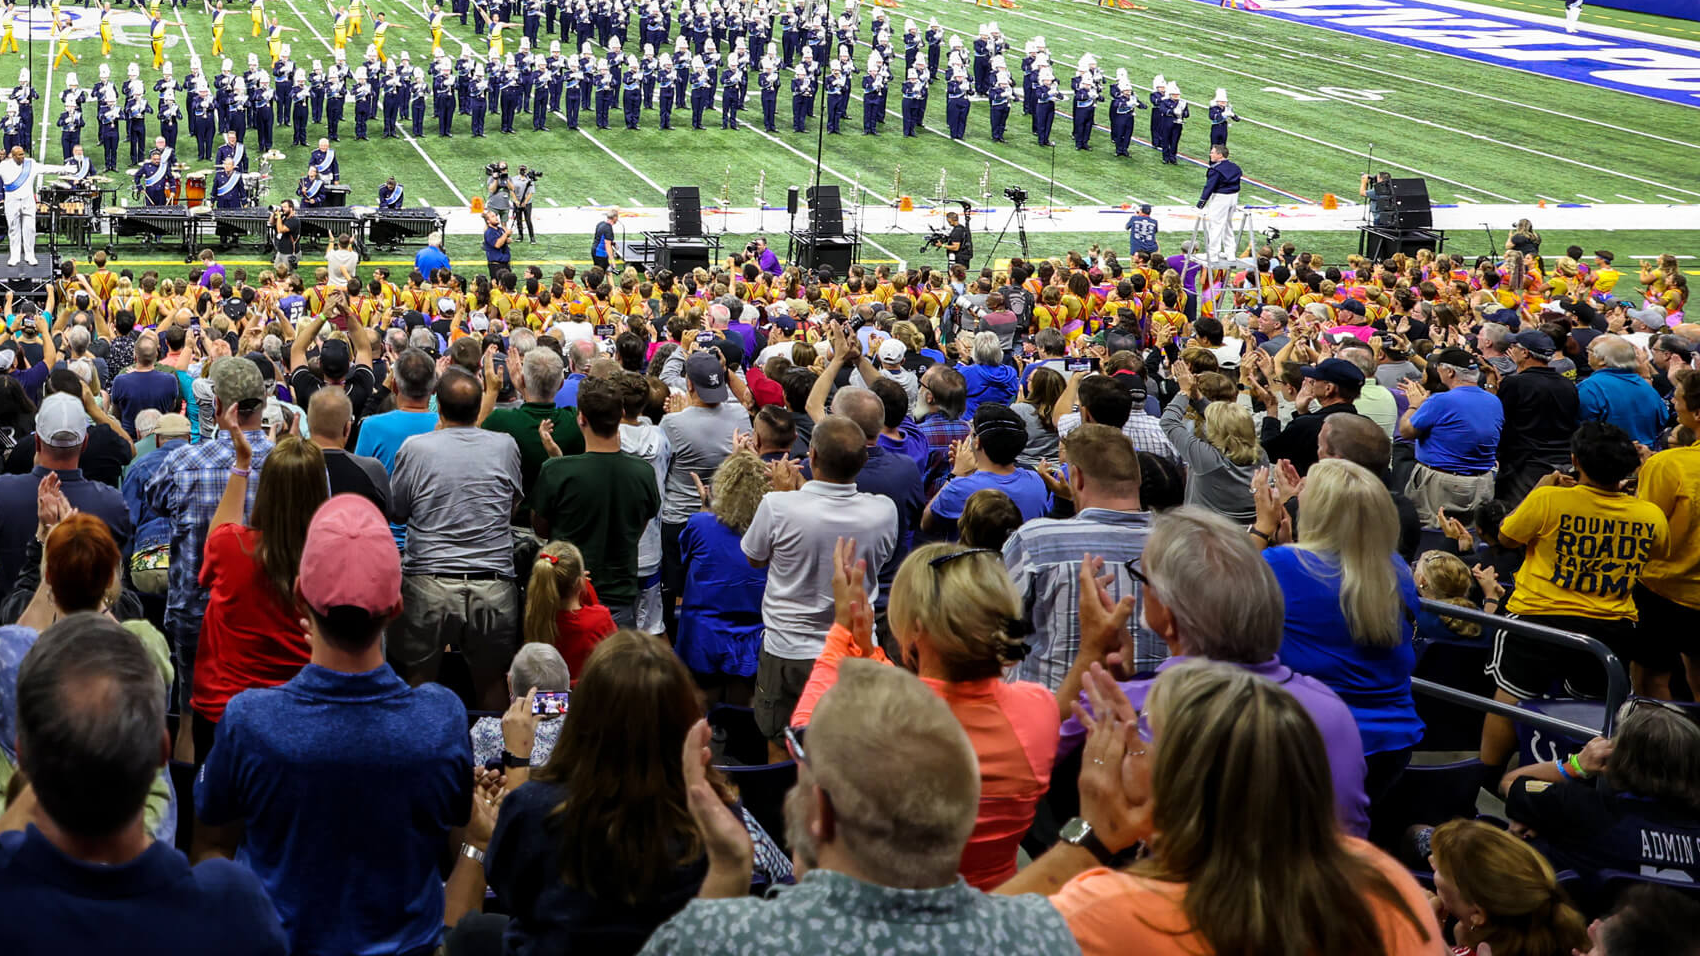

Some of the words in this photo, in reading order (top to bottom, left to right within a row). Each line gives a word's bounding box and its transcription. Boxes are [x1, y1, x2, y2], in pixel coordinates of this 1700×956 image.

[1560, 514, 1655, 538] COUNTRY
[1555, 531, 1653, 563] ROADS
[1556, 552, 1603, 572] TAKE
[1625, 561, 1644, 576] M
[1550, 565, 1630, 598] HOM
[1641, 829, 1695, 864] ADMIN
